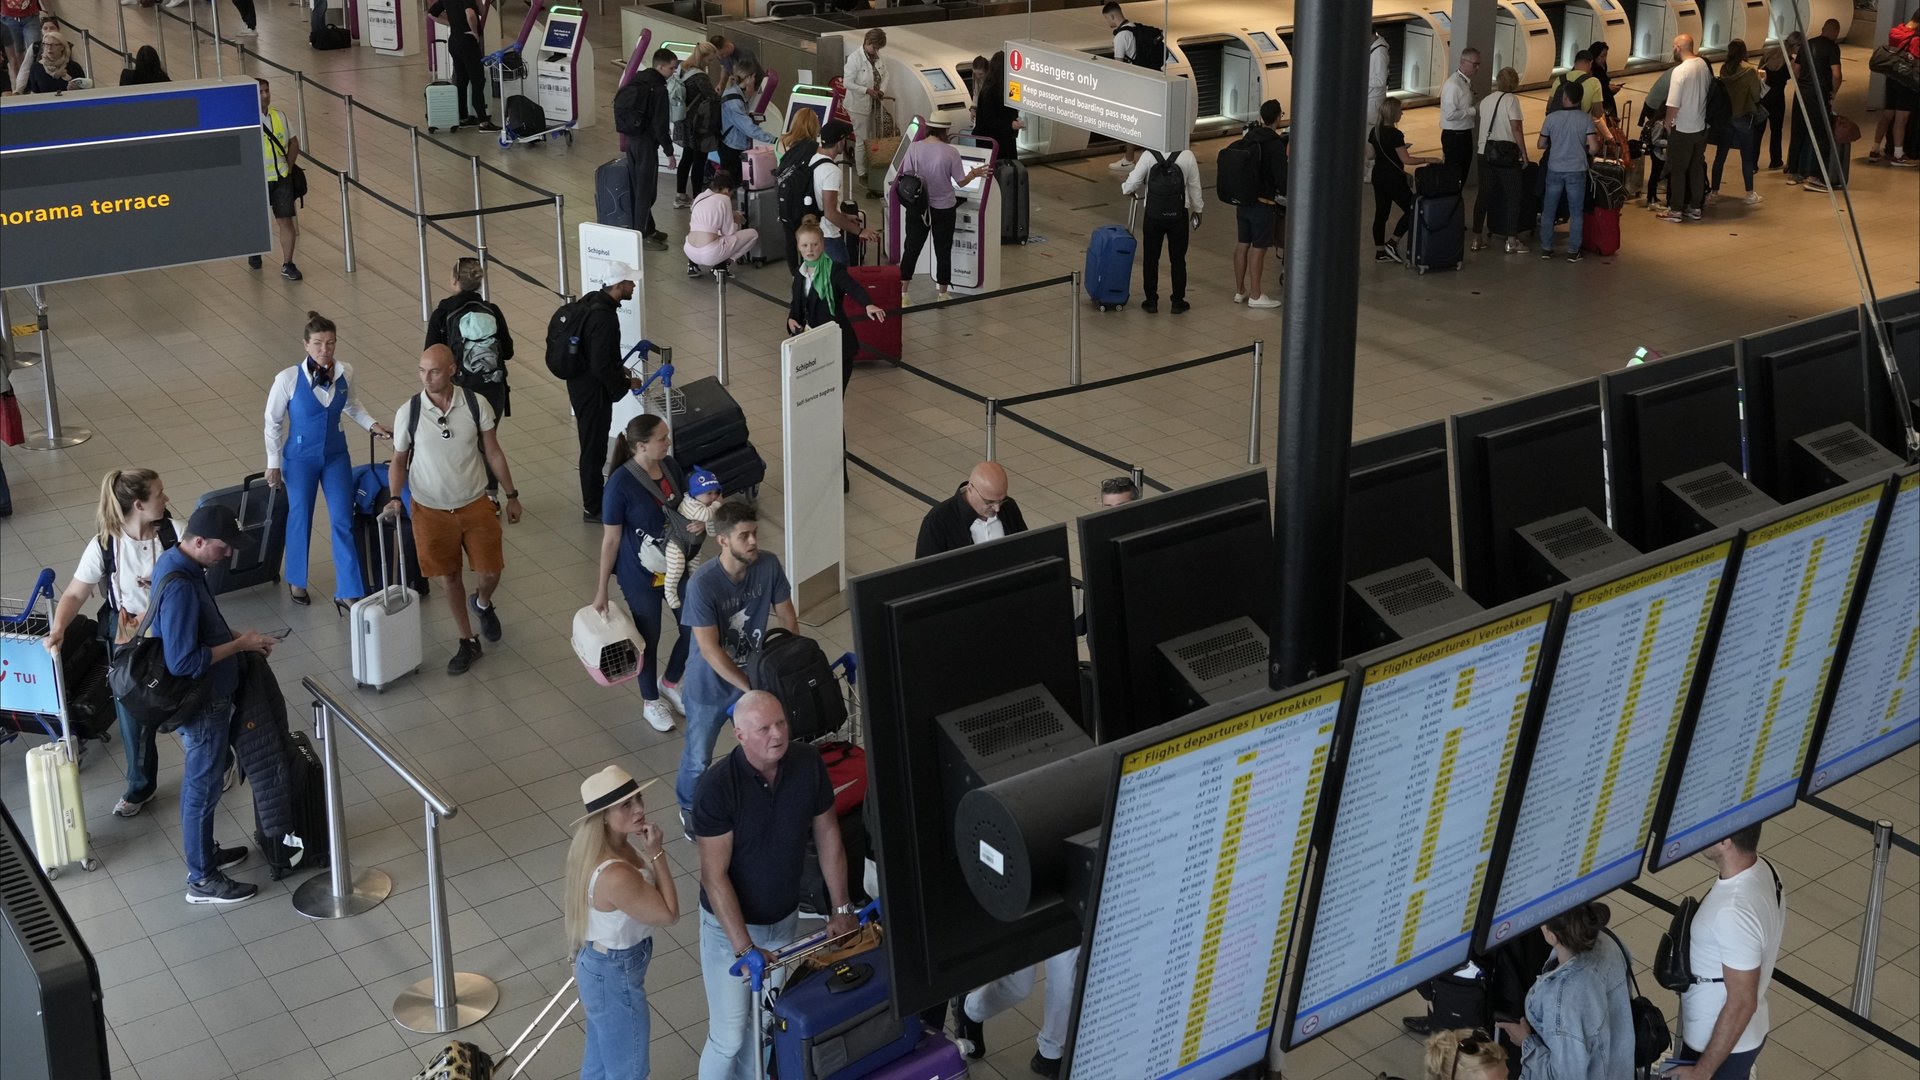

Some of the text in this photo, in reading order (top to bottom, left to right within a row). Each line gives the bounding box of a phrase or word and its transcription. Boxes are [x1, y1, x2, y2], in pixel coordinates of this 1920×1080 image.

[1025, 57, 1098, 90] Passengers only
[1023, 84, 1138, 125] Keep passport and boarding pass ready
[1023, 97, 1047, 111] Paspoort
[1056, 105, 1082, 122] boarding
[1084, 114, 1096, 126] pass
[1098, 116, 1142, 139] gereedhouden
[90, 193, 170, 215] terrace
[588, 247, 610, 256] Schiphol
[796, 358, 816, 373] Schiphol
[1586, 552, 1715, 603] Flight departures Vertrekken
[1382, 655, 1414, 675] Flight
[1415, 638, 1471, 662] departures
[1478, 615, 1532, 640] Vertrekken
[14, 672, 36, 684] TUI
[1122, 765, 1160, 786] 12:40:22
[1314, 706, 1333, 718] June
[1144, 740, 1181, 763] Flight
[1183, 720, 1249, 749] departures
[1258, 694, 1322, 723] Vertrekken
[1328, 976, 1408, 1021] No smoking
